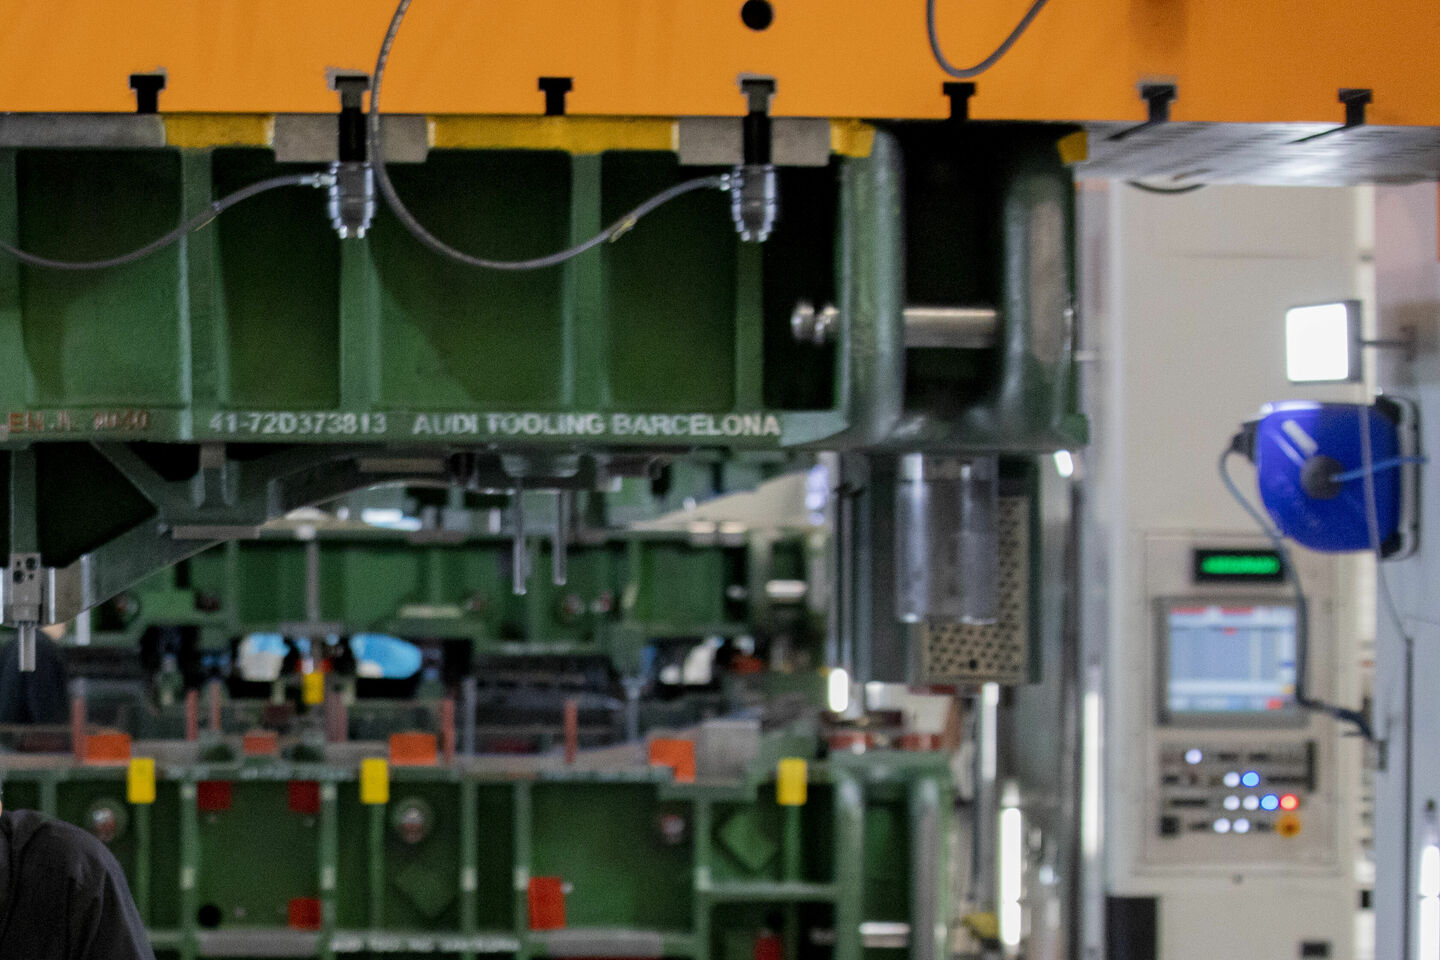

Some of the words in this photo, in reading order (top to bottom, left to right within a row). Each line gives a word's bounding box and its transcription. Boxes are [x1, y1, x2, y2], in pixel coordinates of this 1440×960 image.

[412, 412, 479, 435] AUDI
[486, 412, 605, 435] TOOLING
[613, 412, 782, 436] BARCELONA
